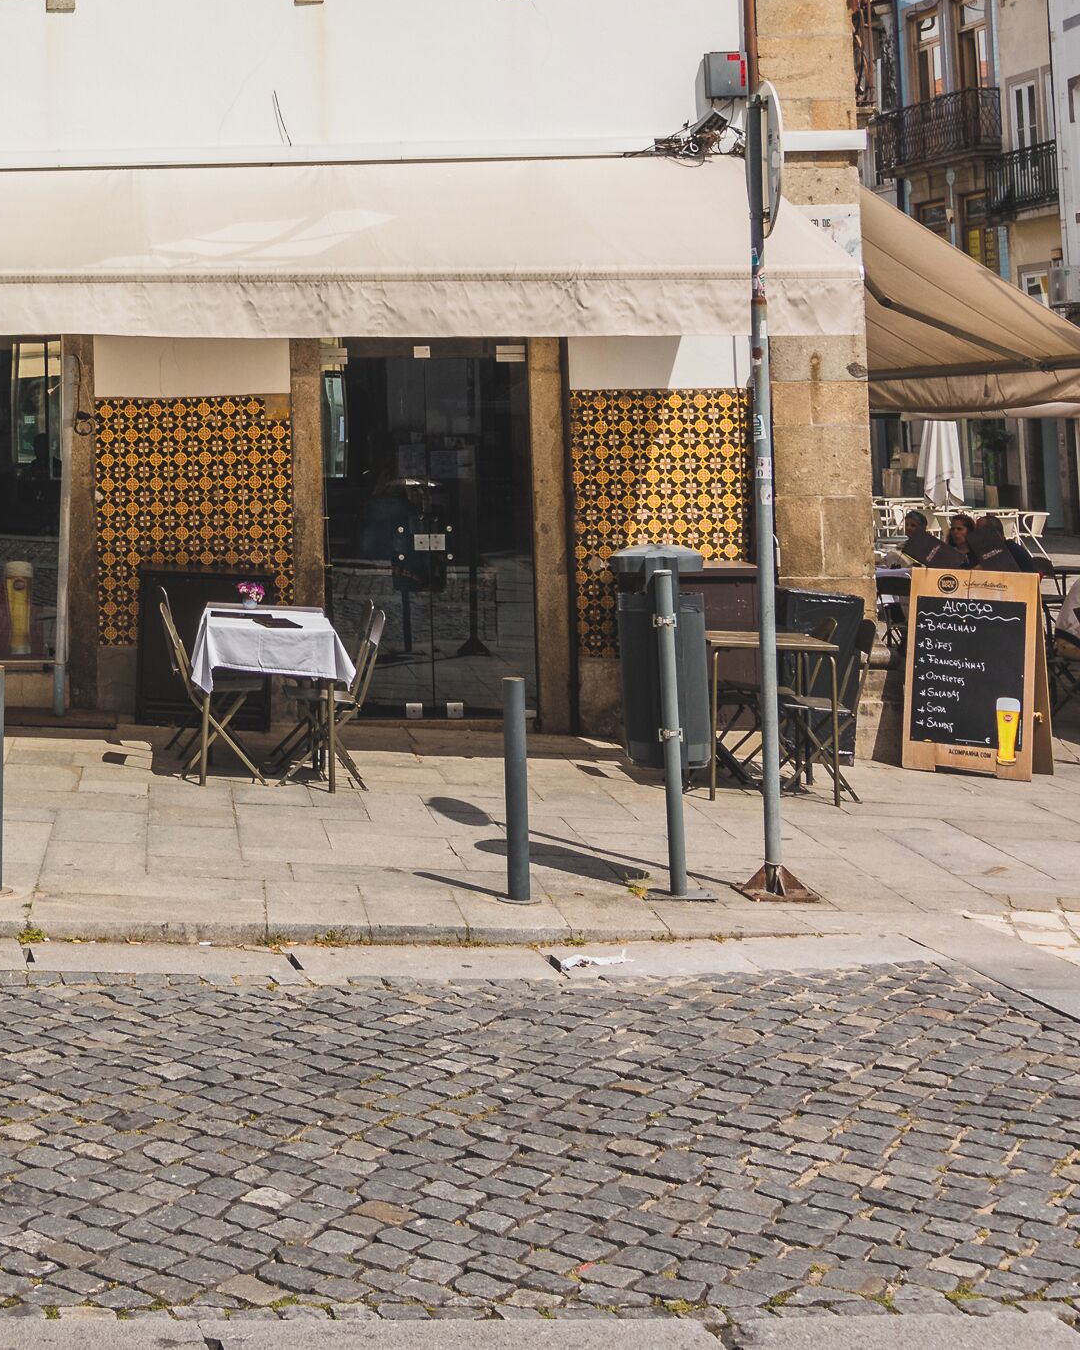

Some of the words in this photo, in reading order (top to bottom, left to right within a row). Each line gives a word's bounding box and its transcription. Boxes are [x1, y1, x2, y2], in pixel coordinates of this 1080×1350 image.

[822, 218, 831, 227] DE
[925, 619, 977, 633] BACALHAU
[927, 687, 960, 701] SALADAS
[948, 748, 980, 758] ACOMPANHA
